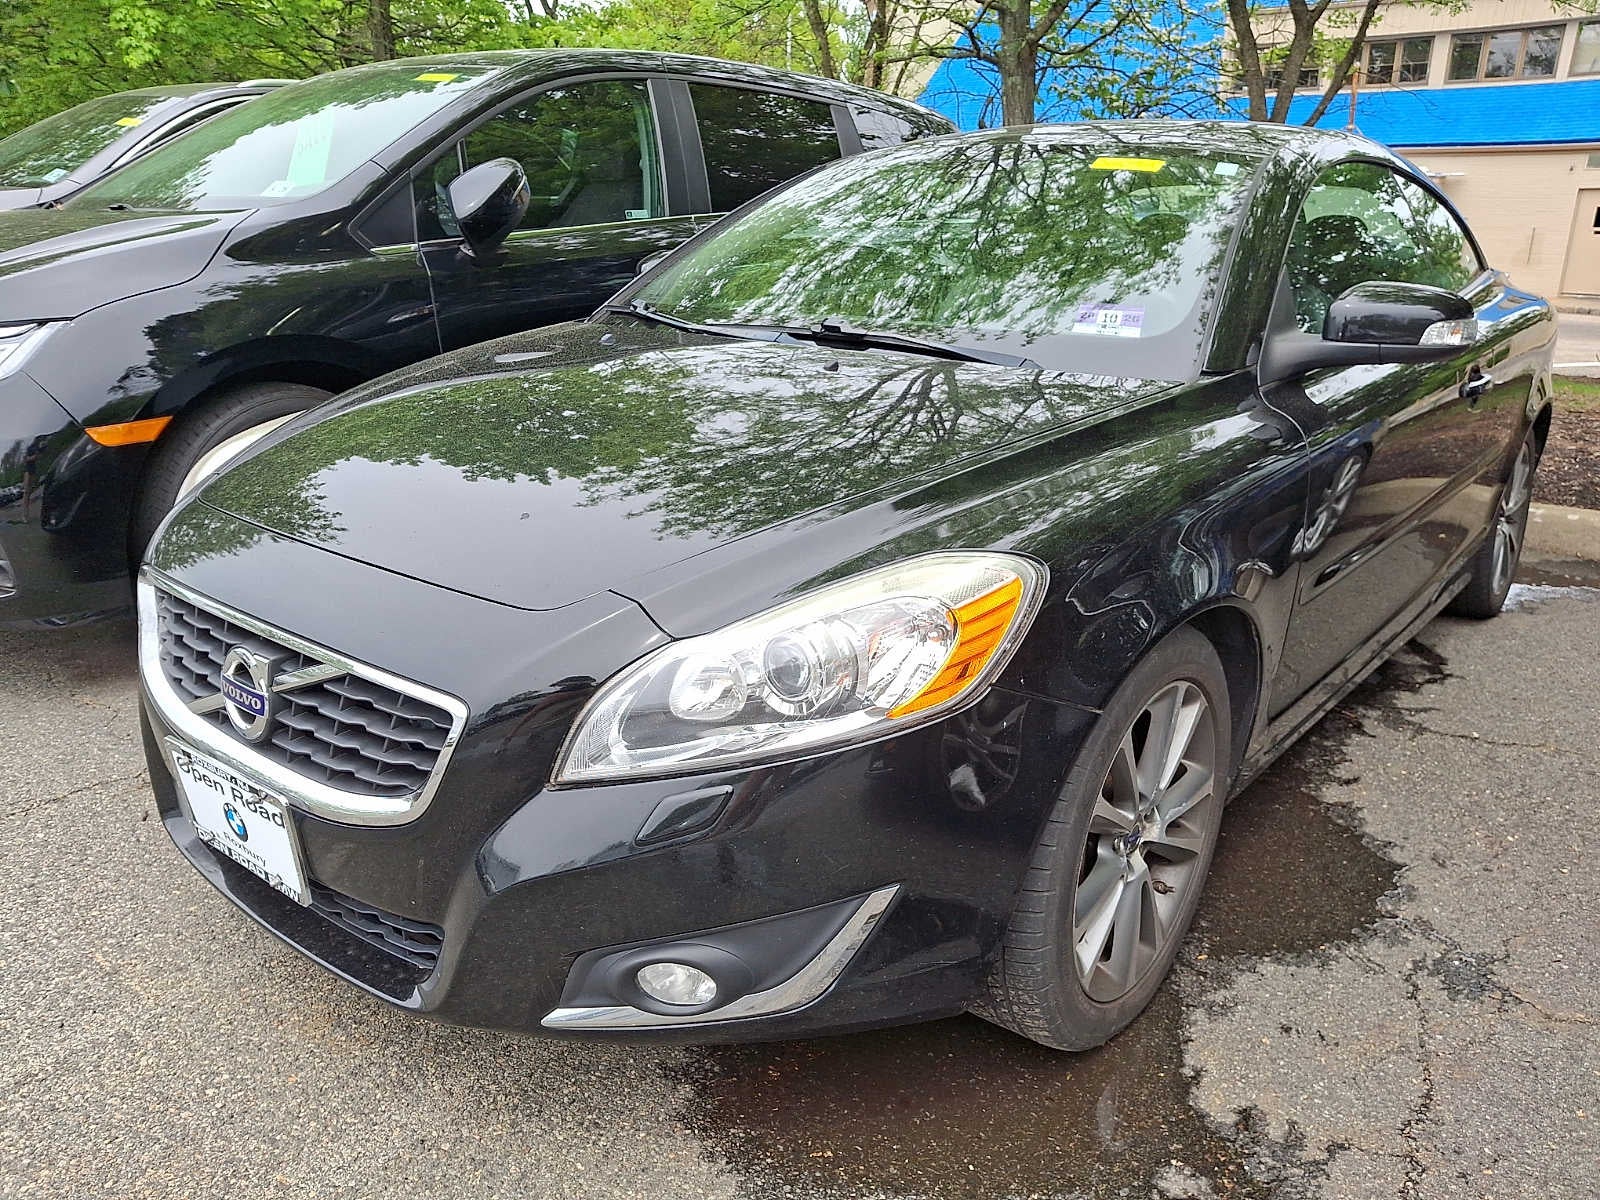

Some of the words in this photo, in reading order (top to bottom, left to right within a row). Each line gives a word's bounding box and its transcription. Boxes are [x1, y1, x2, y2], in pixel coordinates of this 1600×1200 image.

[1101, 312, 1118, 323] 10
[223, 681, 263, 710] VOLVO
[177, 756, 225, 795] Open
[230, 786, 286, 829] Road
